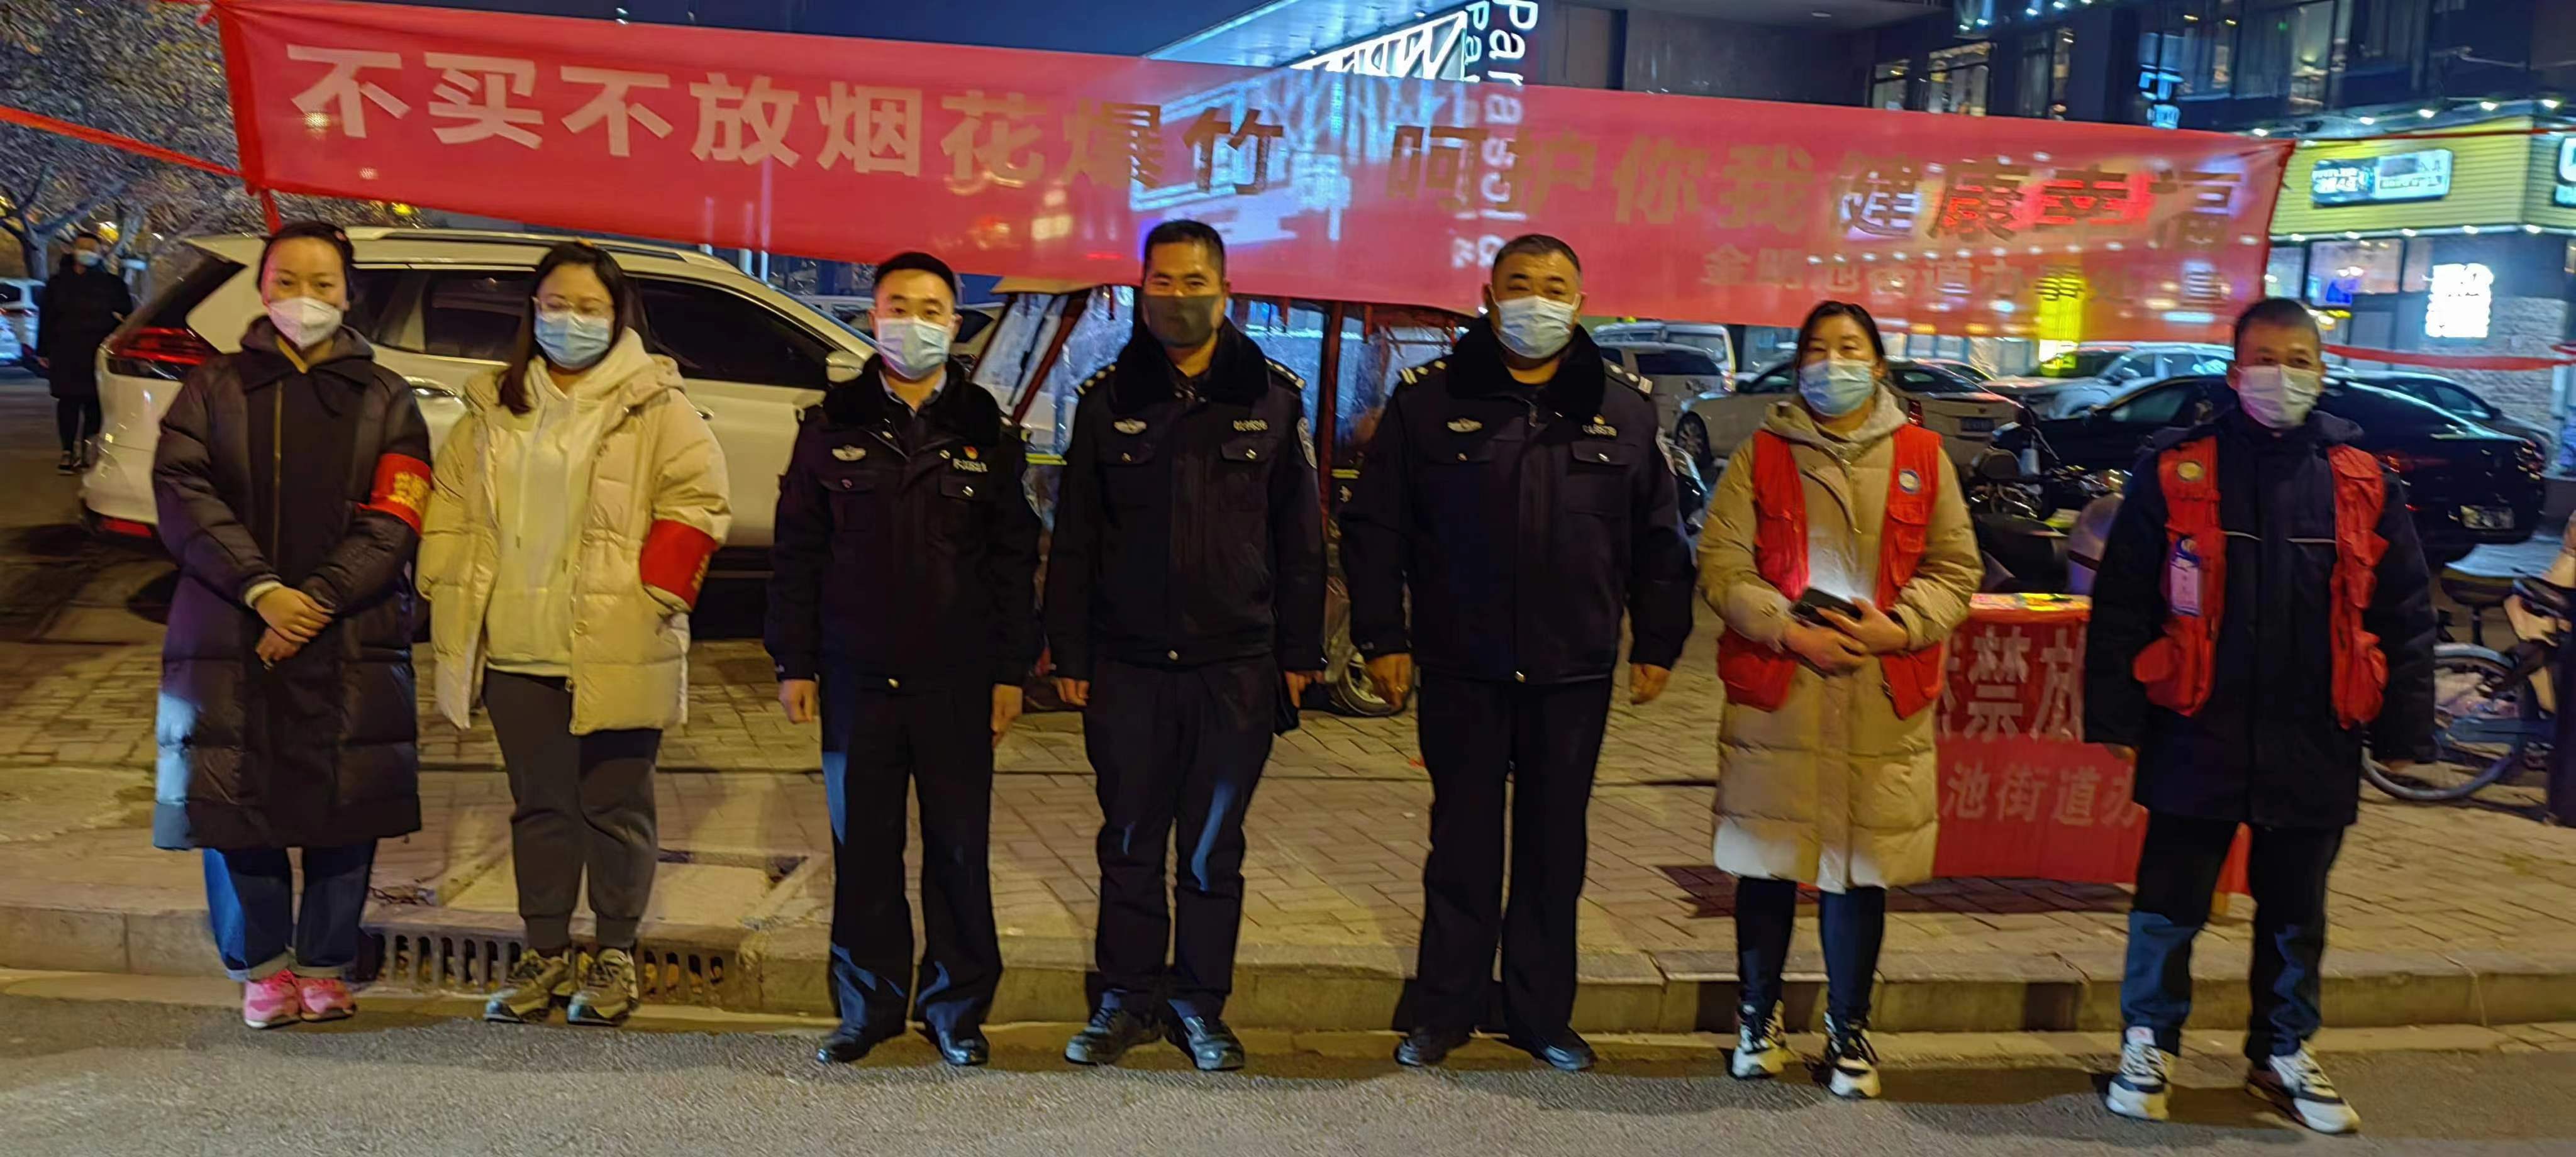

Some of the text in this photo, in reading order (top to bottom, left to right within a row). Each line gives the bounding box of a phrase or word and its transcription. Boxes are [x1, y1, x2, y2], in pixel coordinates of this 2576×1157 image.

[287, 44, 2242, 253] 不买不放烟花爆竹 呵护你我健康幸福
